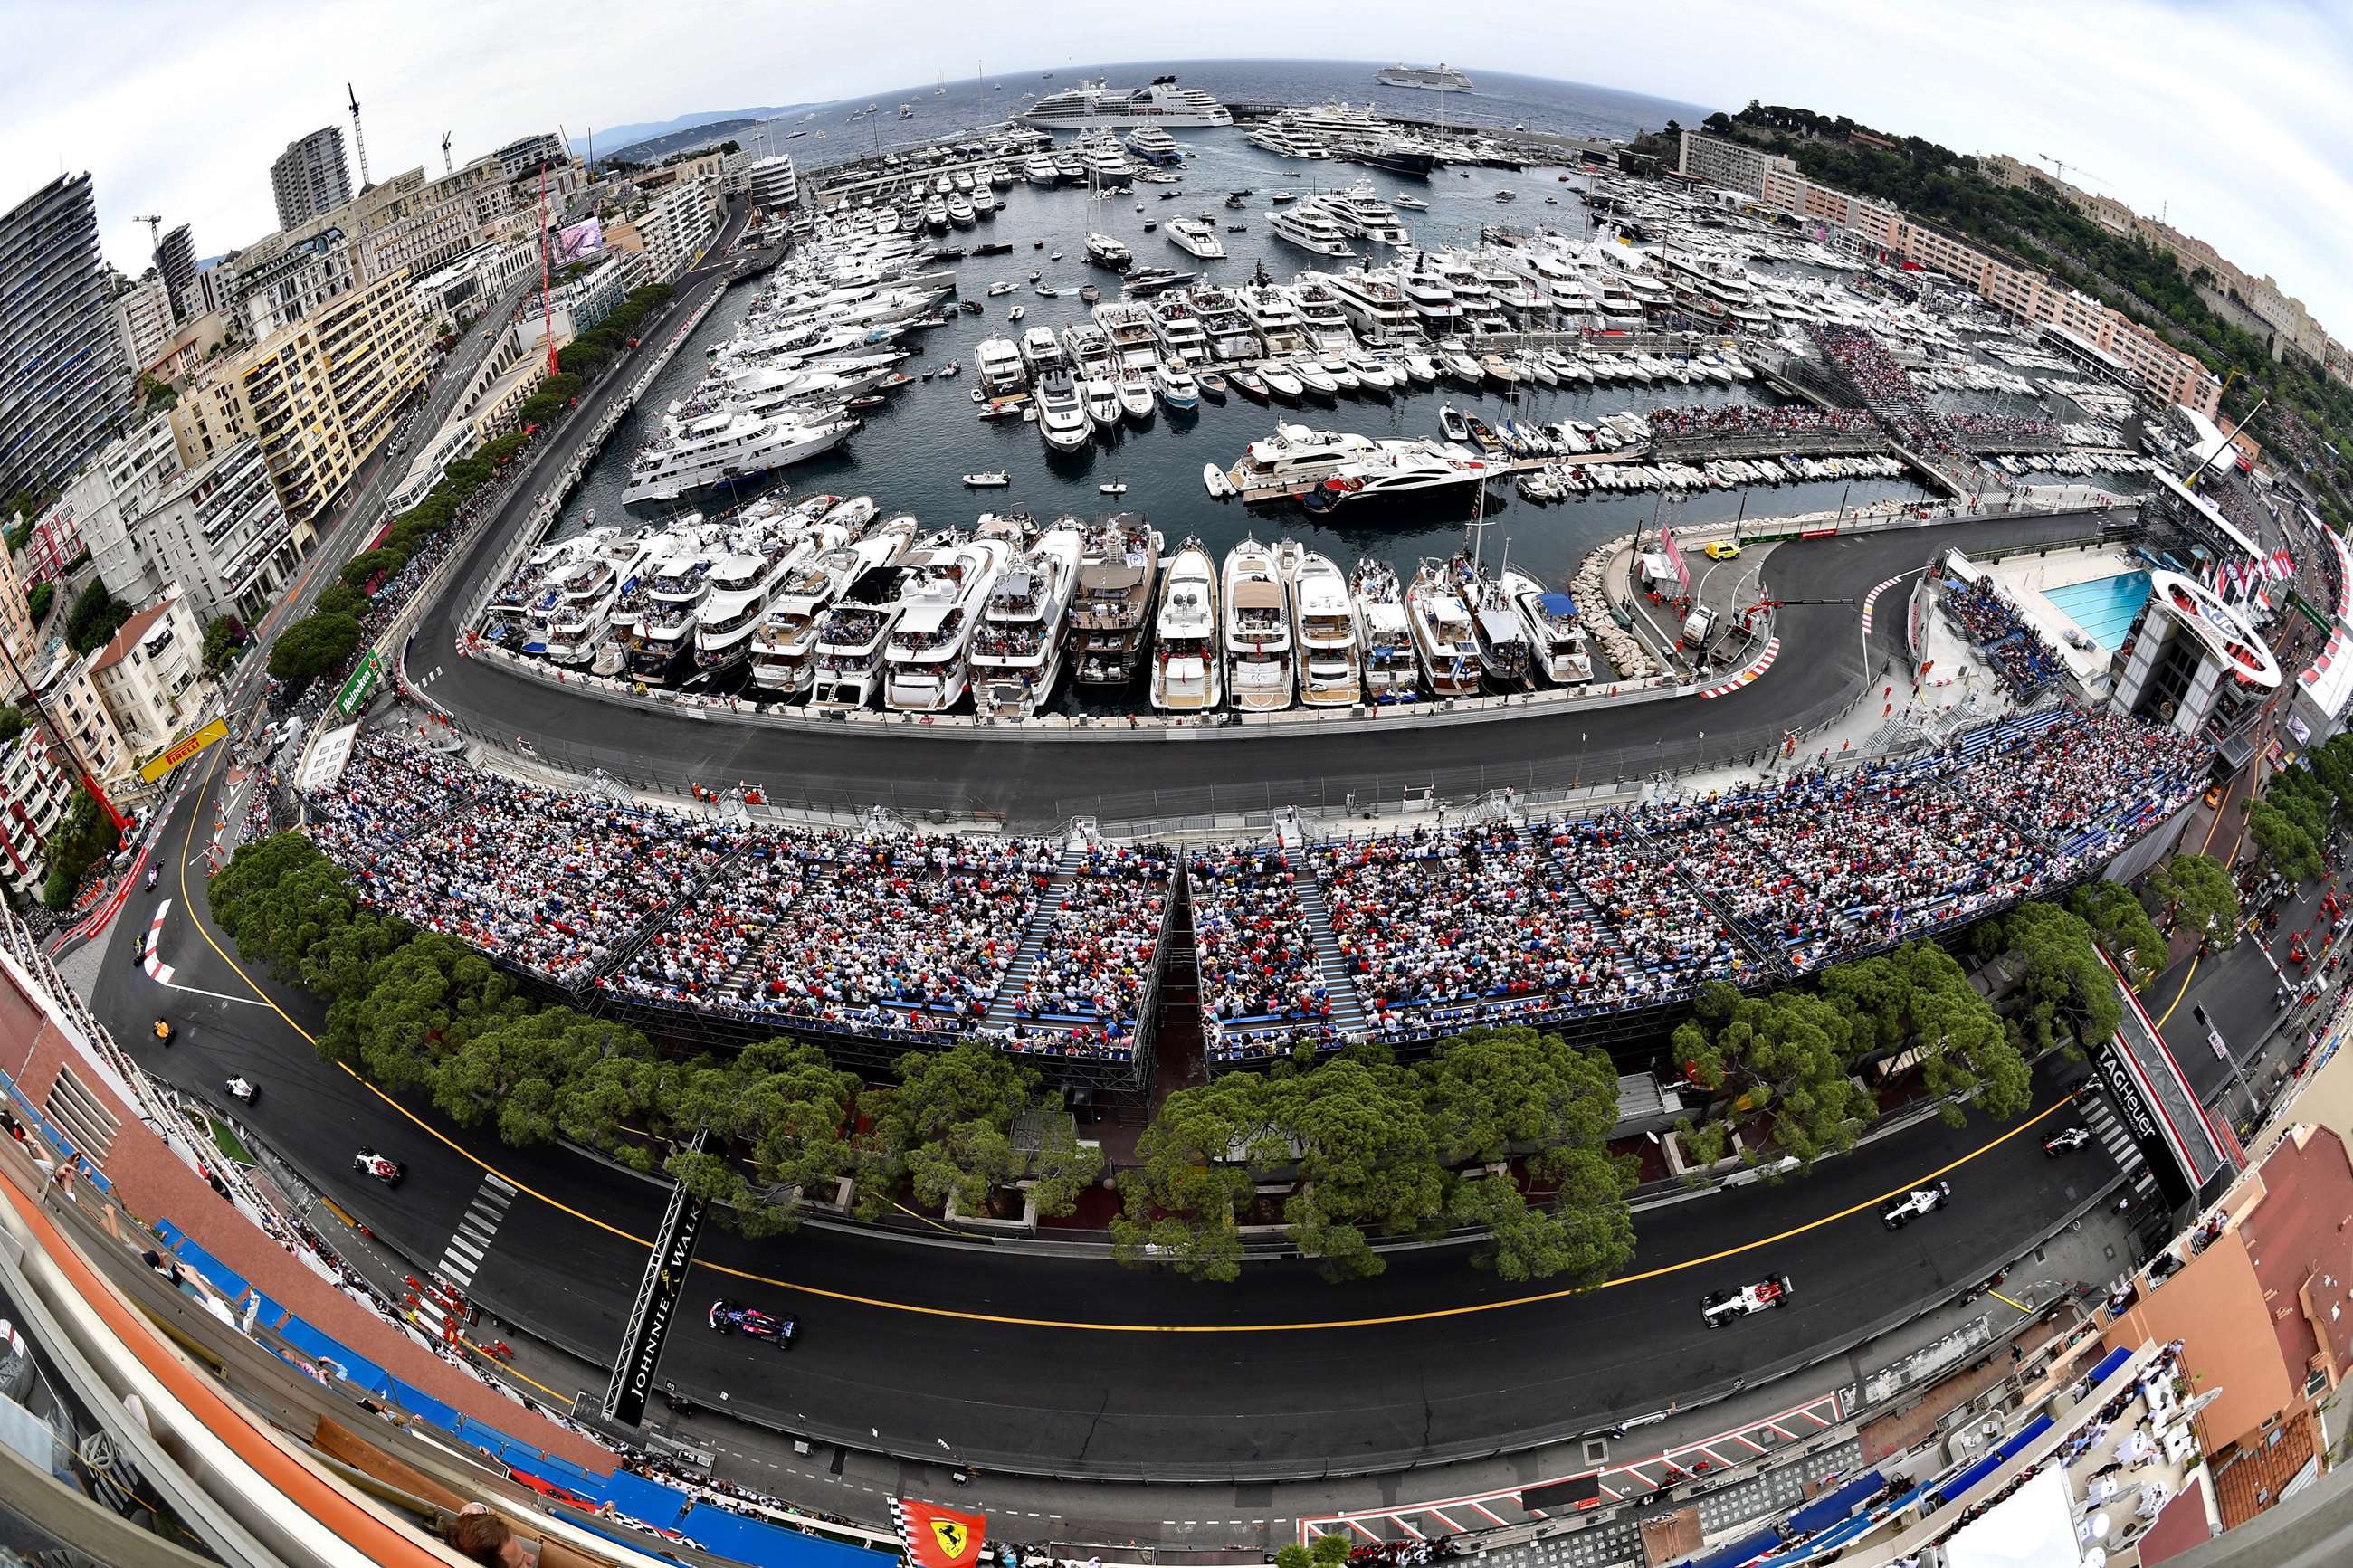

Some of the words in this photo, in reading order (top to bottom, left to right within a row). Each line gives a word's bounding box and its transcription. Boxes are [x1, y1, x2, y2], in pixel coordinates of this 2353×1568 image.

[341, 670, 371, 713] Heineken
[165, 736, 201, 765] PIRELLI
[2213, 1039, 2225, 1058] UBS
[2110, 1085, 2123, 1107] WATCH
[2122, 1105, 2139, 1132] MONACO
[631, 1297, 670, 1403] JOHNNIE
